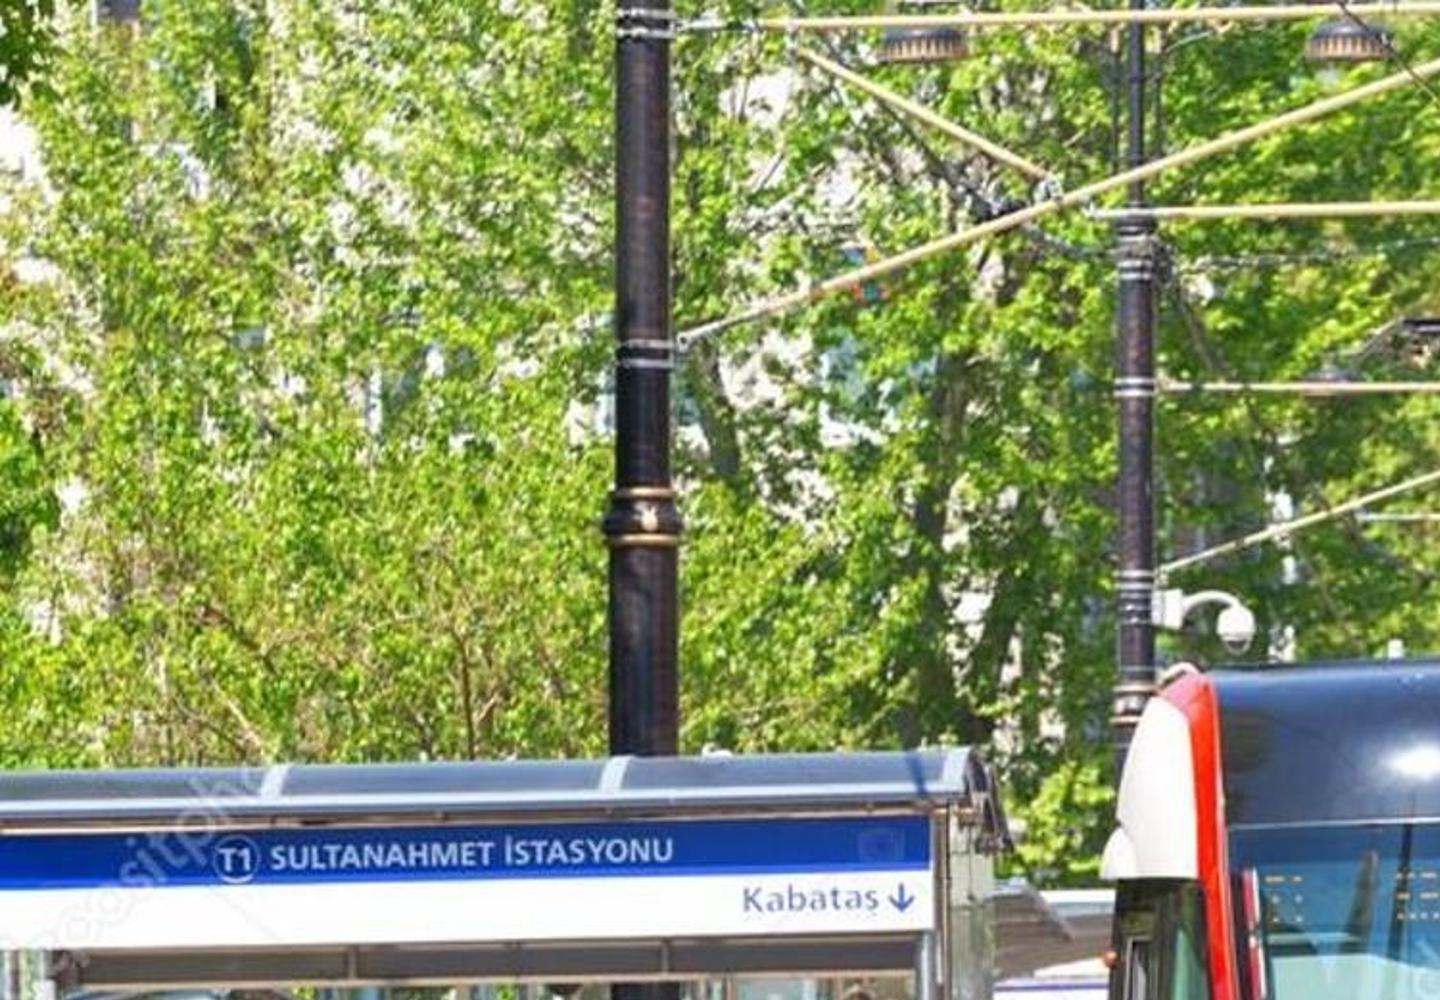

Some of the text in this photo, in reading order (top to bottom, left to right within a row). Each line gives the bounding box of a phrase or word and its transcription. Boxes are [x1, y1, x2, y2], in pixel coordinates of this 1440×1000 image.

[217, 835, 675, 873] T1 SULTANAHMET İSTASYONU
